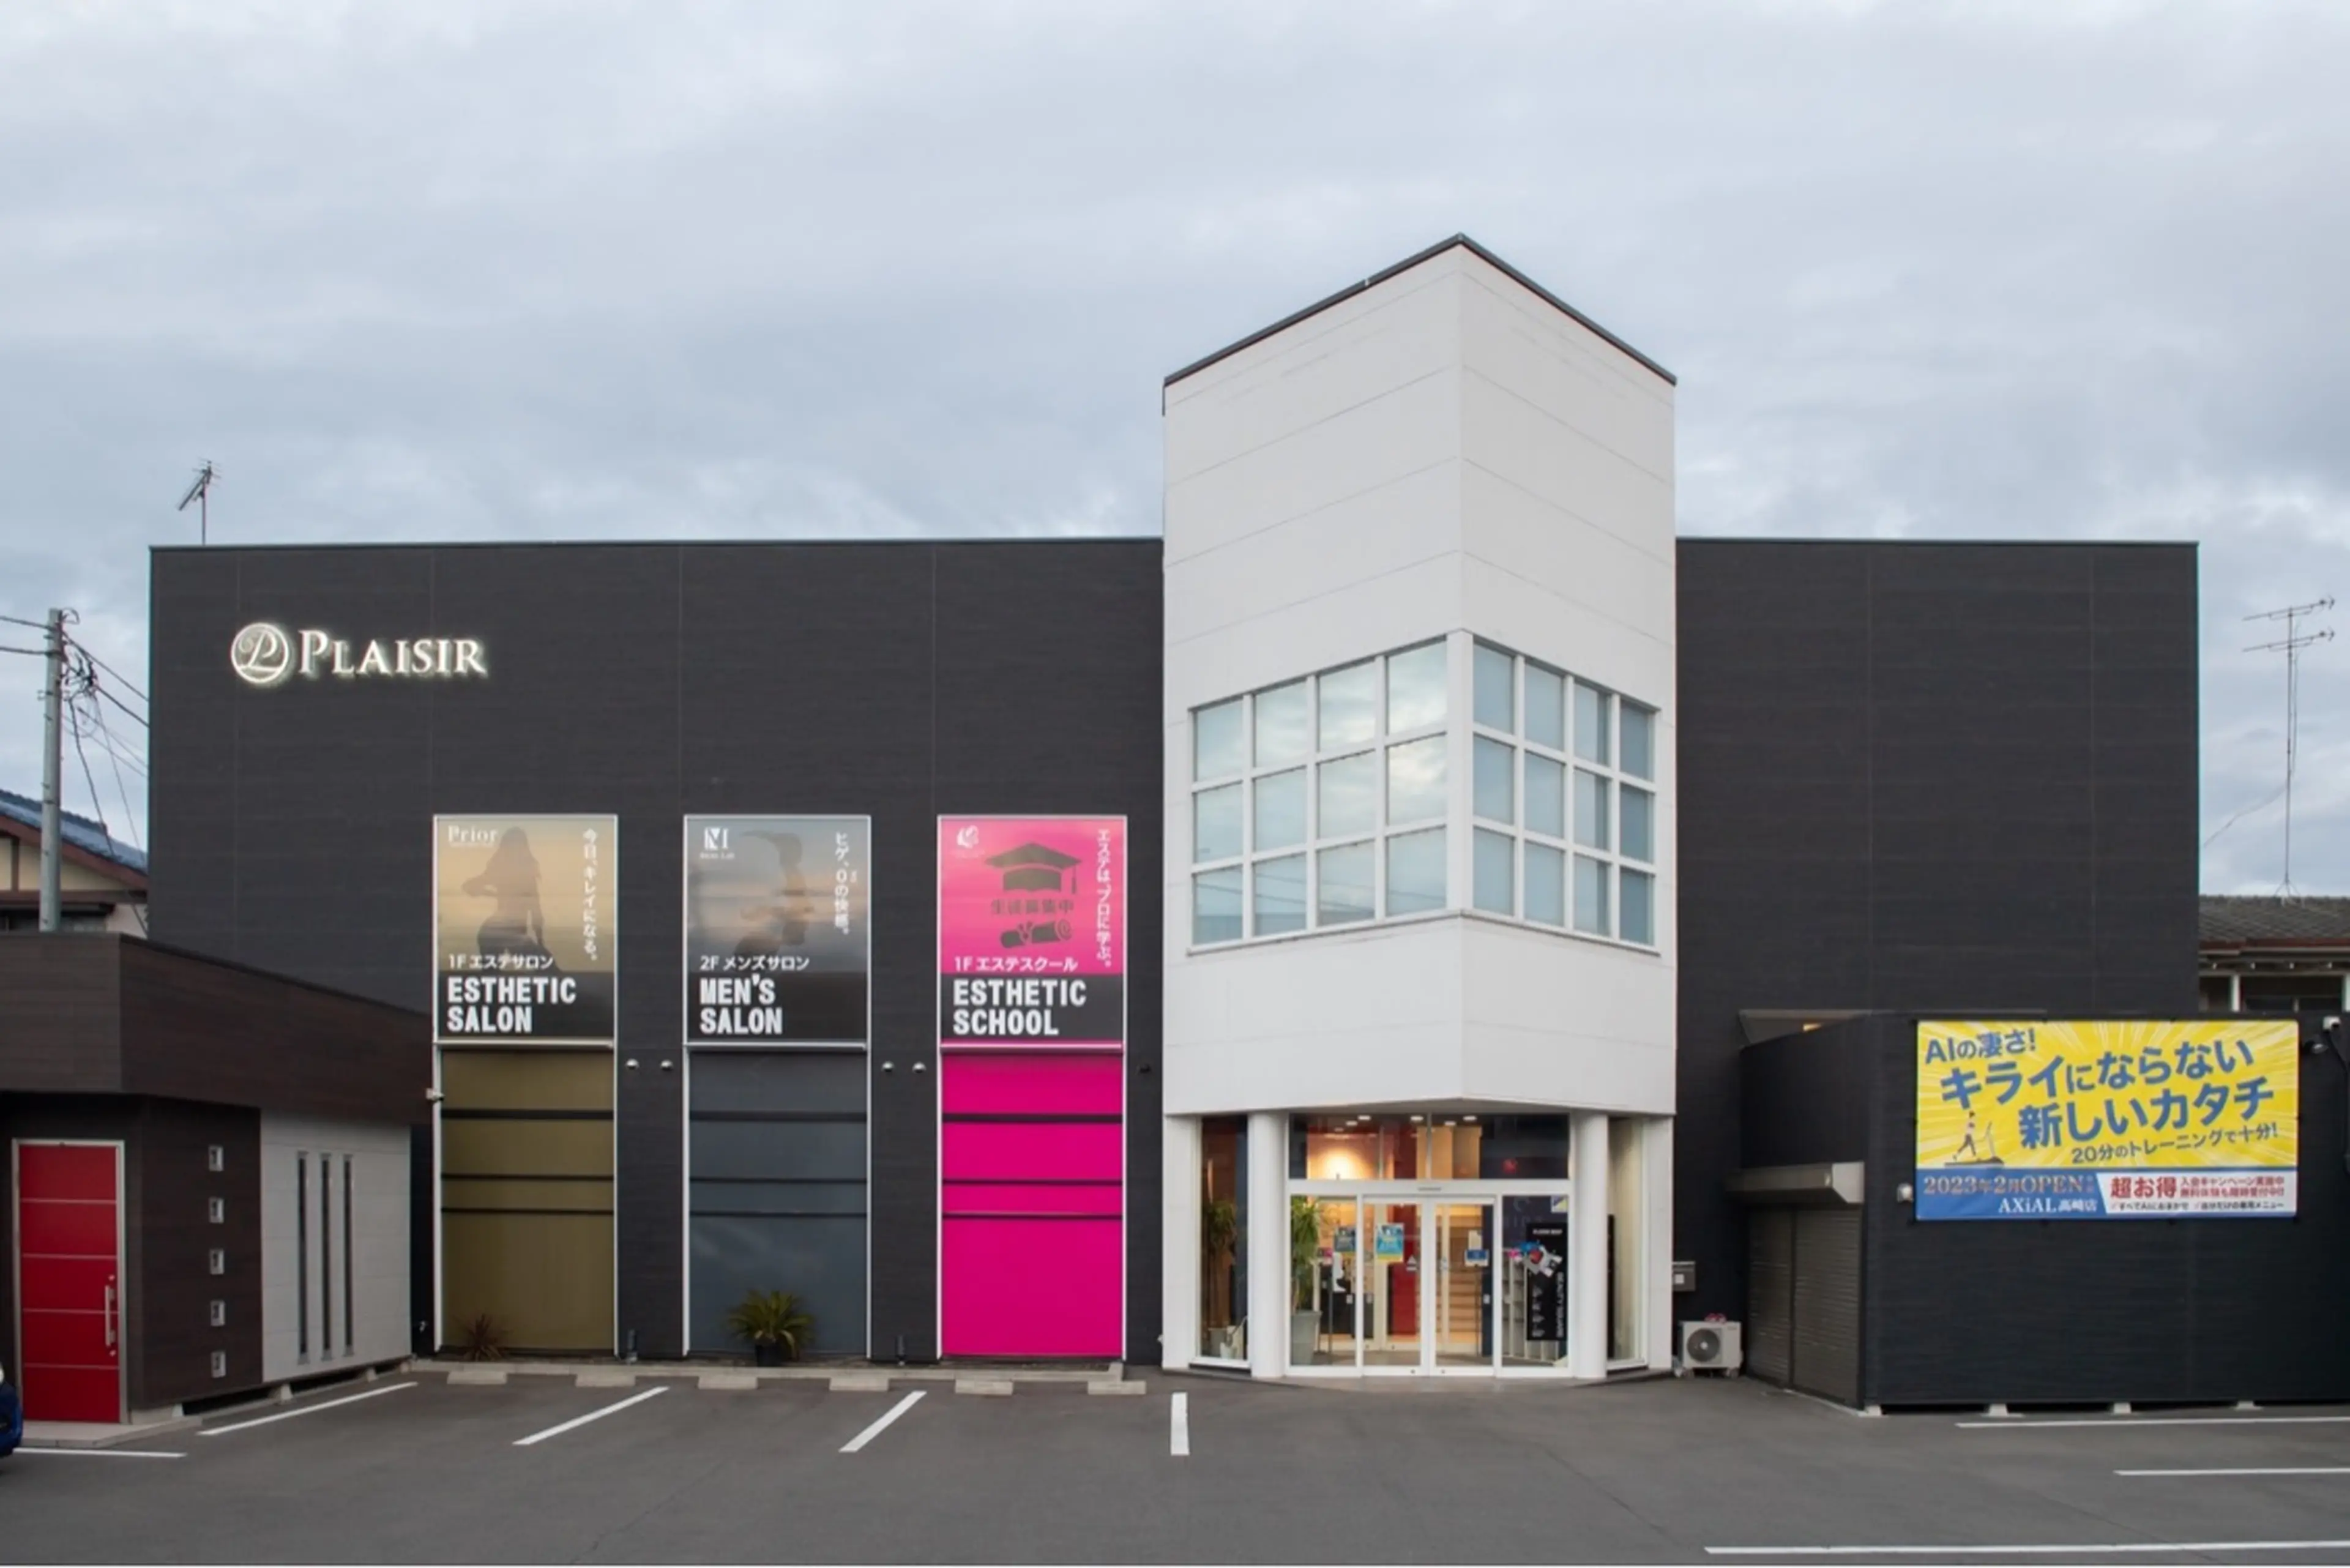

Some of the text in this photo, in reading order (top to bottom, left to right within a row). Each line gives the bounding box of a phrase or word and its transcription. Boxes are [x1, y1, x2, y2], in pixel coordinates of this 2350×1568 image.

[298, 629, 488, 675] PLAISIR
[447, 825, 498, 843] Prior
[448, 954, 553, 969] 1F エステサロン
[700, 955, 810, 971] 2F メンズサロン
[954, 956, 1078, 972] 1F エステスクール
[447, 977, 576, 1004] ESTHETIC
[699, 973, 776, 1005] MEN'S
[953, 979, 1087, 1007] ESTHETIC
[447, 1006, 532, 1032] SALON
[699, 1007, 783, 1034] SALON
[953, 1009, 1059, 1036] SCHOOL
[1940, 1040, 2255, 1110] キライにならない
[2018, 1075, 2275, 1150] 新しいカタチ
[2110, 1176, 2177, 1199] 超お得
